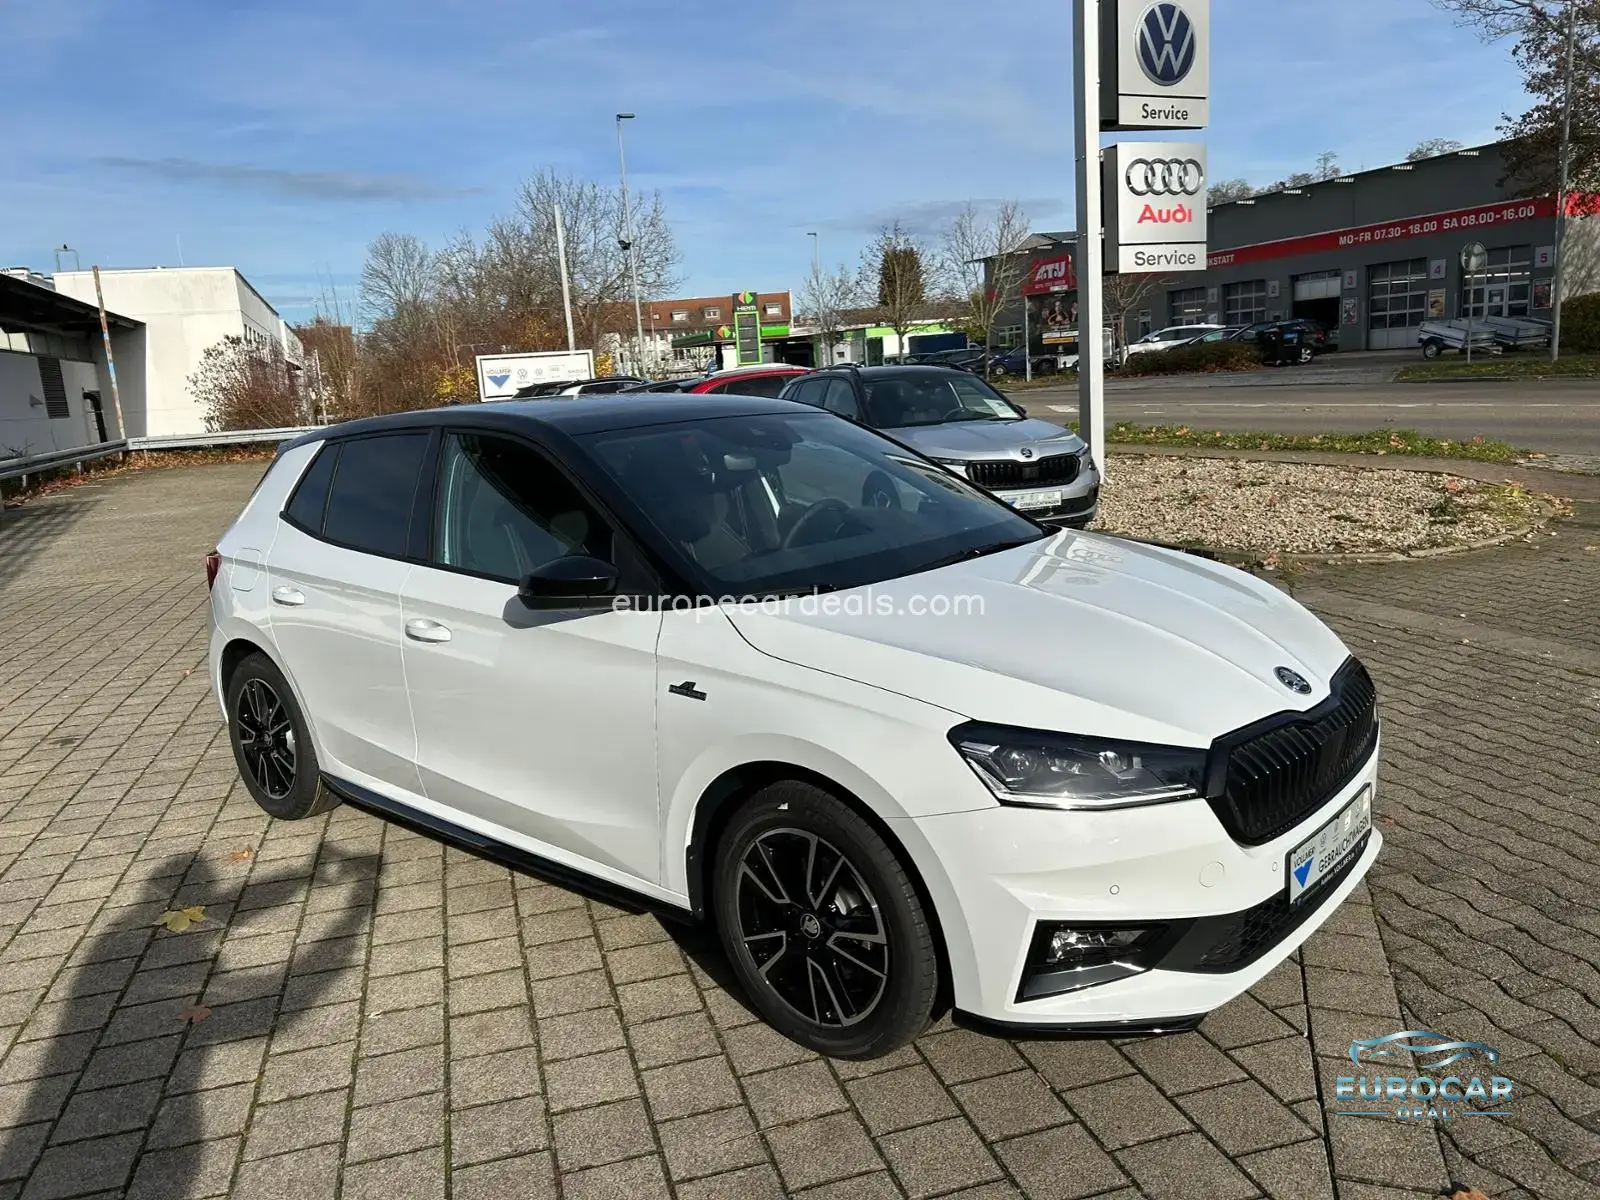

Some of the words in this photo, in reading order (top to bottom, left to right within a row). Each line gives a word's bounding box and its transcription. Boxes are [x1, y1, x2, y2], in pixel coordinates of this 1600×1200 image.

[1141, 103, 1189, 121] Service
[1137, 204, 1192, 224] Audi
[1339, 231, 1372, 246] MO-FR
[1442, 217, 1458, 230] SA
[1134, 249, 1196, 267] Service
[1540, 252, 1548, 263] 5
[1432, 264, 1441, 274] 4
[1318, 815, 1369, 873] GEBRAUCHTWAGEN
